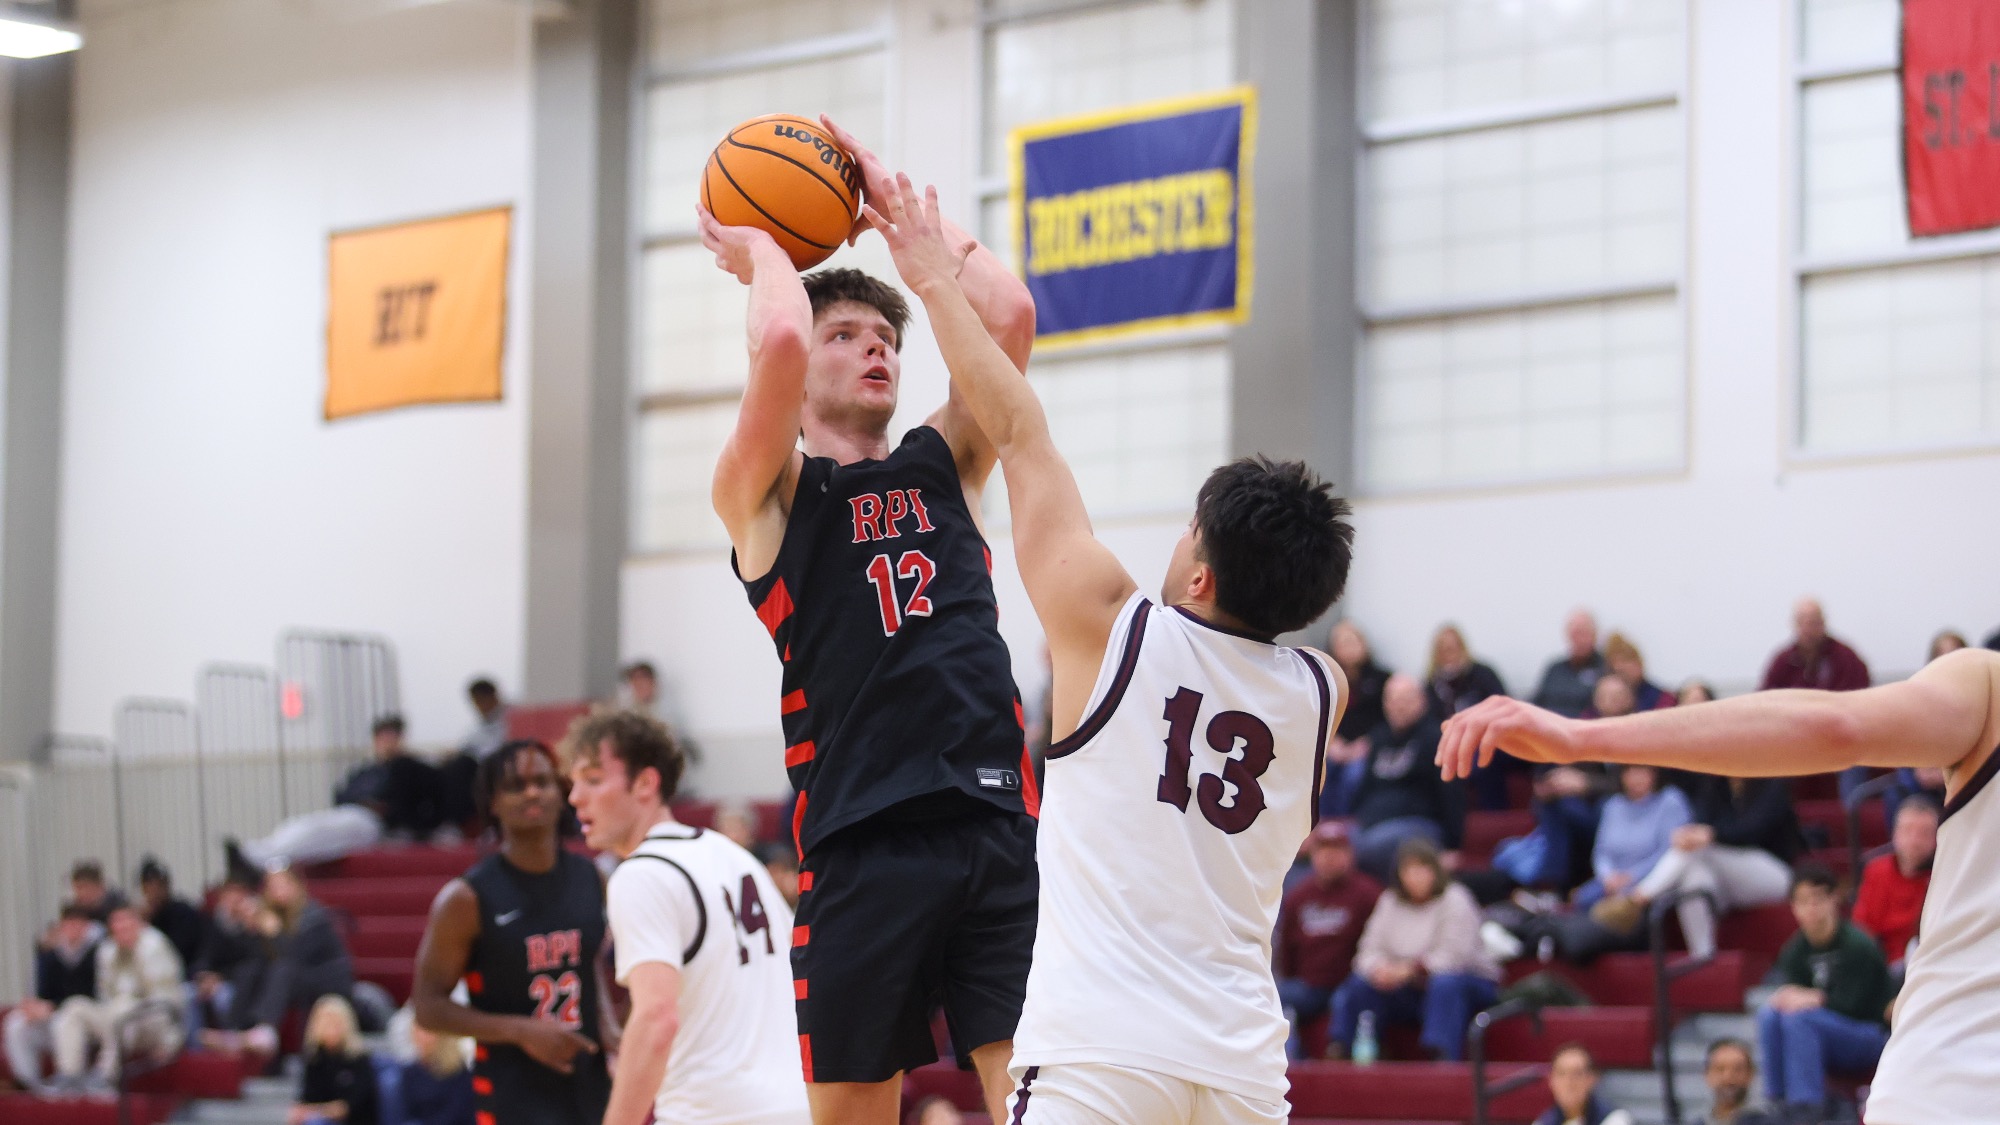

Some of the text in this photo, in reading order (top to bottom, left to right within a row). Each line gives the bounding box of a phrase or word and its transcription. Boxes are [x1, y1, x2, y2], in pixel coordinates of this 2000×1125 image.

[774, 124, 858, 198] Wilson
[1028, 168, 1234, 276] ROCHESTER
[847, 488, 936, 543] RPI
[866, 550, 937, 637] 12
[1157, 686, 1276, 834] 13
[525, 929, 582, 973] RPI
[528, 970, 583, 1031] 22
